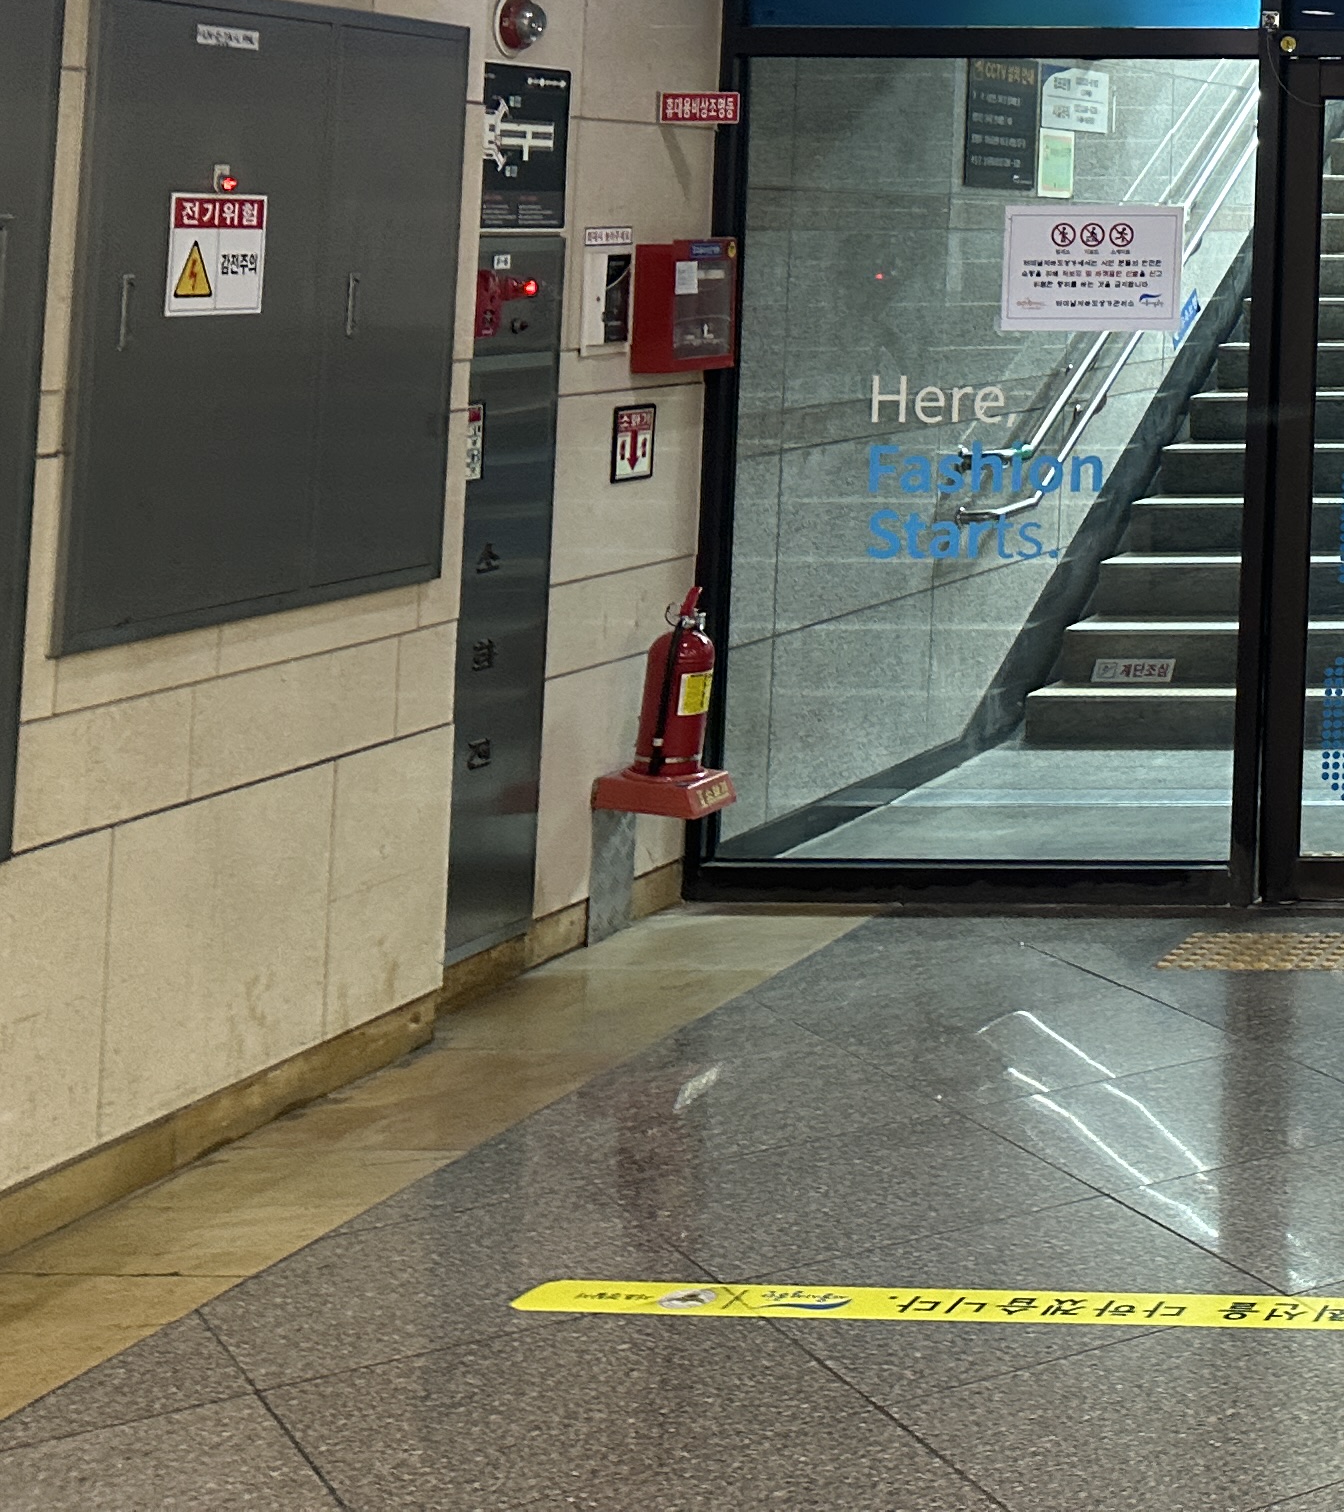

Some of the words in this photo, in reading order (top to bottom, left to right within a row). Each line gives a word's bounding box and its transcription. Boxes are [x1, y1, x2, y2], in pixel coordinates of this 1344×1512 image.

[666, 97, 735, 119] 휴대용비상조명등
[181, 201, 258, 226] 전기위험
[220, 253, 258, 276] 감전주의
[871, 374, 1017, 428] Here,
[867, 440, 1105, 494] Fashion
[866, 508, 1060, 560] Starts.
[889, 1293, 1188, 1318] 다하겠습니다.
